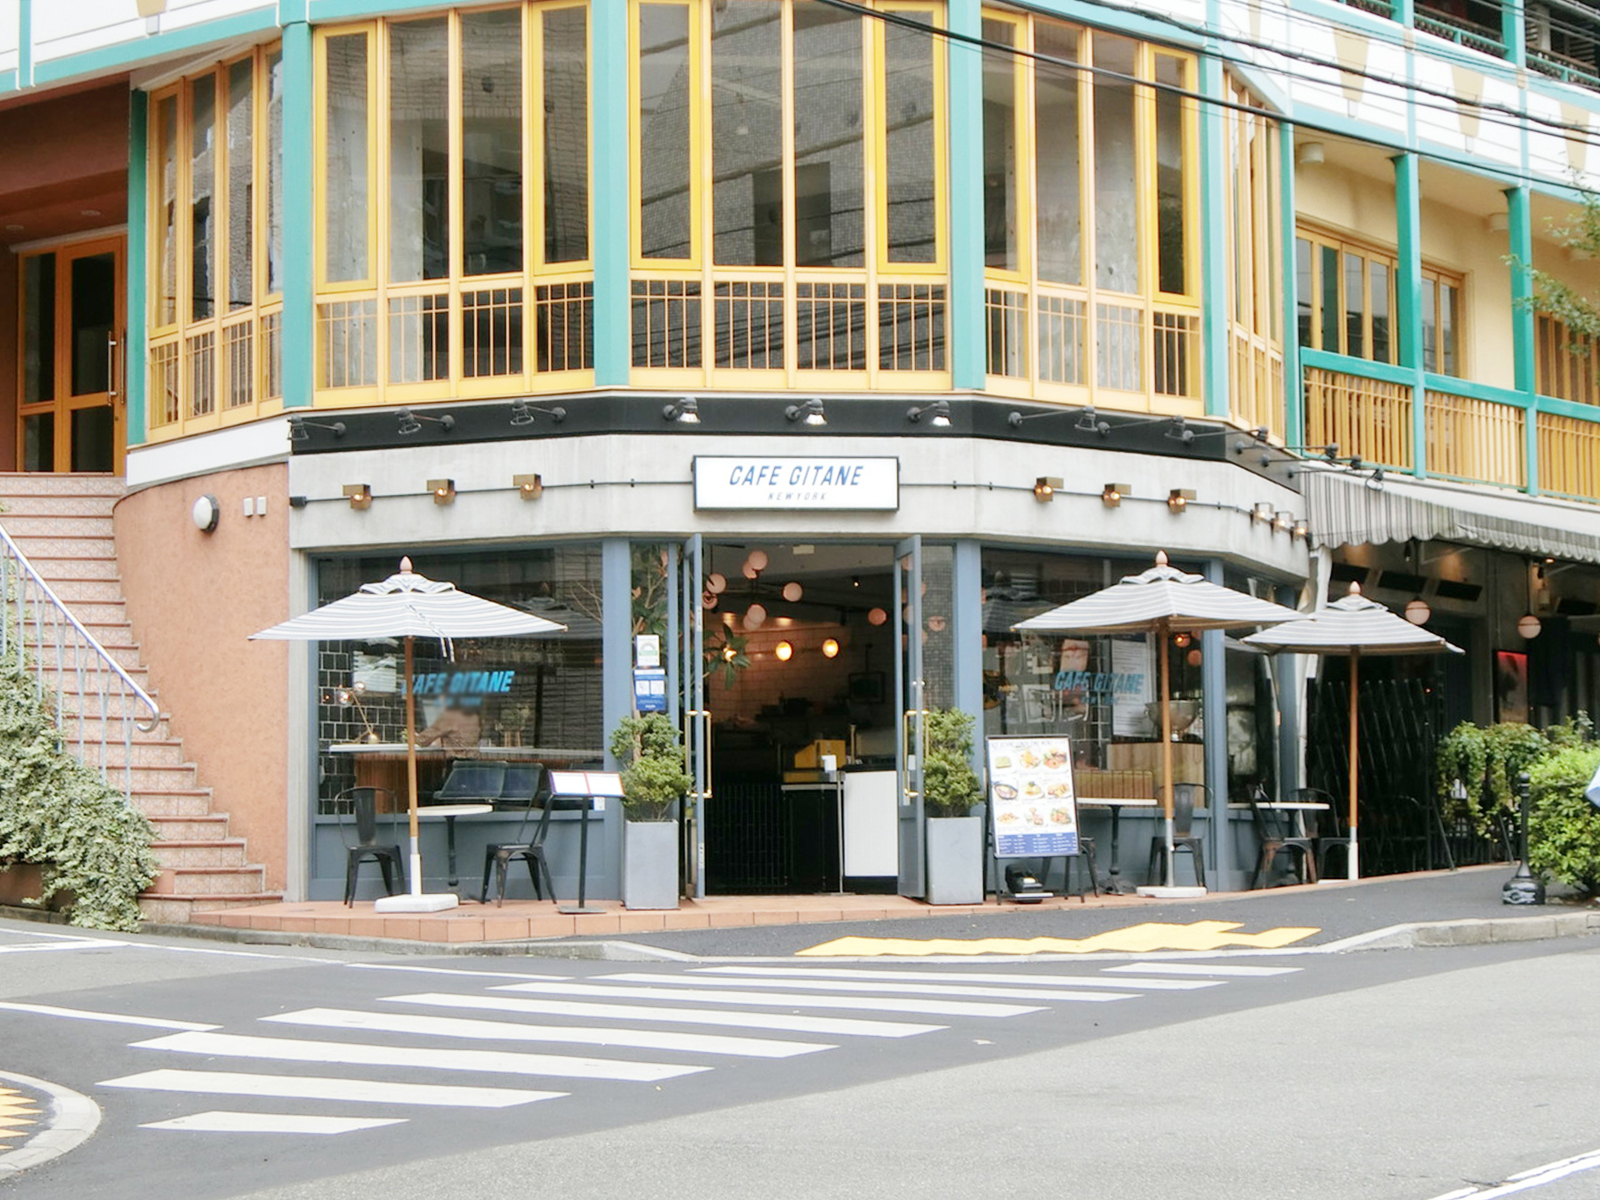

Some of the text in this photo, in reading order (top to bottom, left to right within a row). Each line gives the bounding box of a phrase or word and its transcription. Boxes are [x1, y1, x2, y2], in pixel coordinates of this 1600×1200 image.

[729, 465, 864, 486] CAFE GITANE
[1054, 671, 1144, 694] CAFE GITANE
